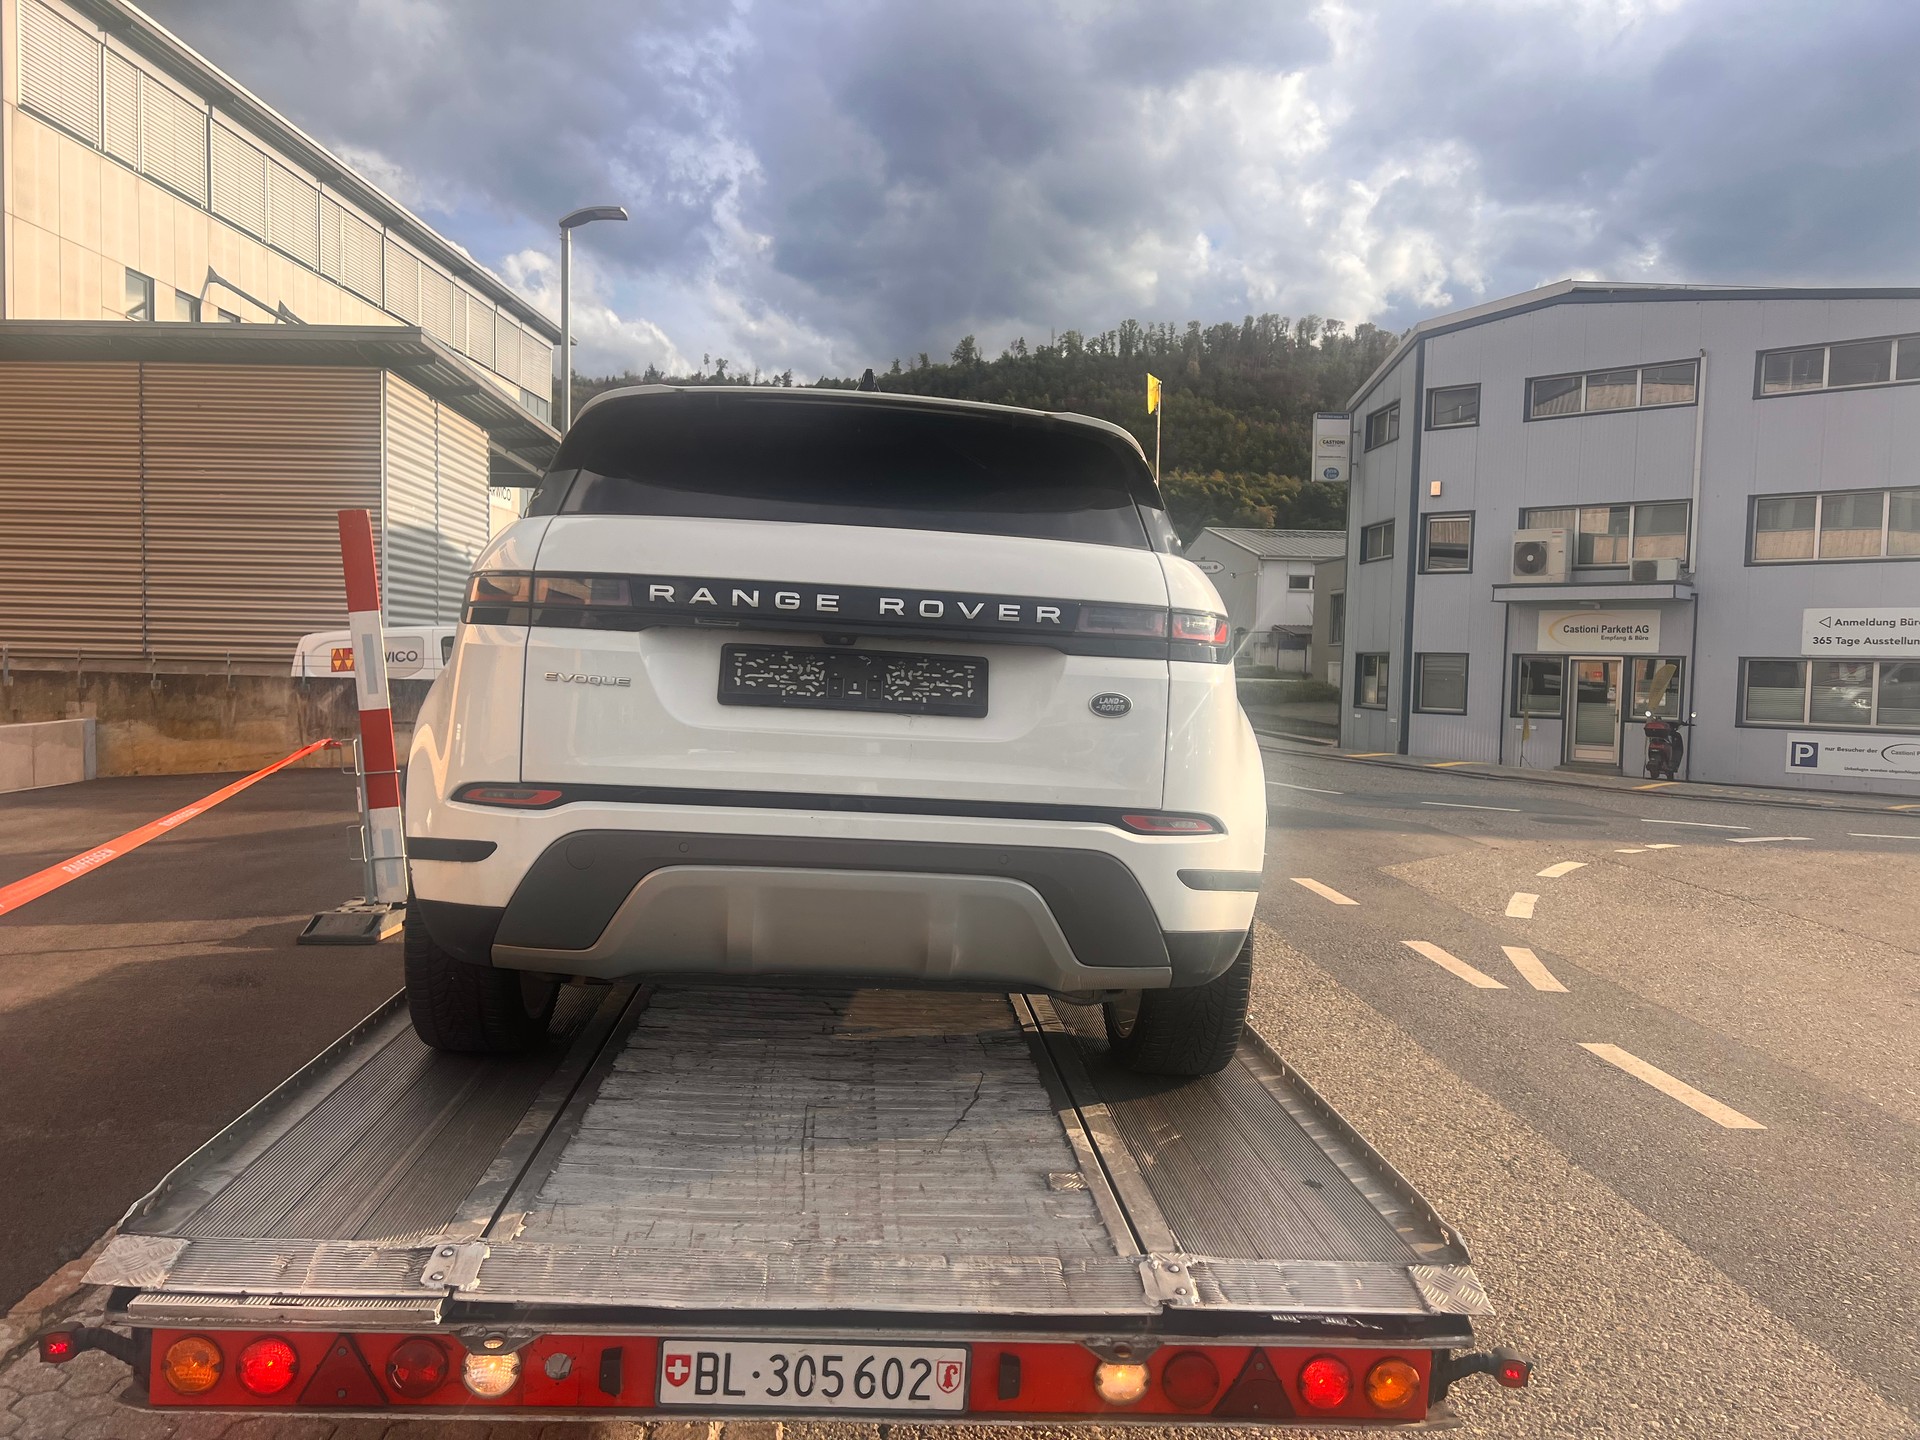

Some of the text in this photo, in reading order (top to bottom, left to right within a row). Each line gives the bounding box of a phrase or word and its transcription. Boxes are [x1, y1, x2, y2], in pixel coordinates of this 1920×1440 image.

[490, 486, 511, 501] RWICO
[648, 584, 1062, 625] RANGE ROVER
[1563, 625, 1649, 633] Castioni Parkett AG
[1834, 618, 1920, 628] Anmeldung Bür
[1812, 636, 1832, 645] 365
[1835, 636, 1860, 647] Tage
[544, 672, 631, 687] EVOQUE
